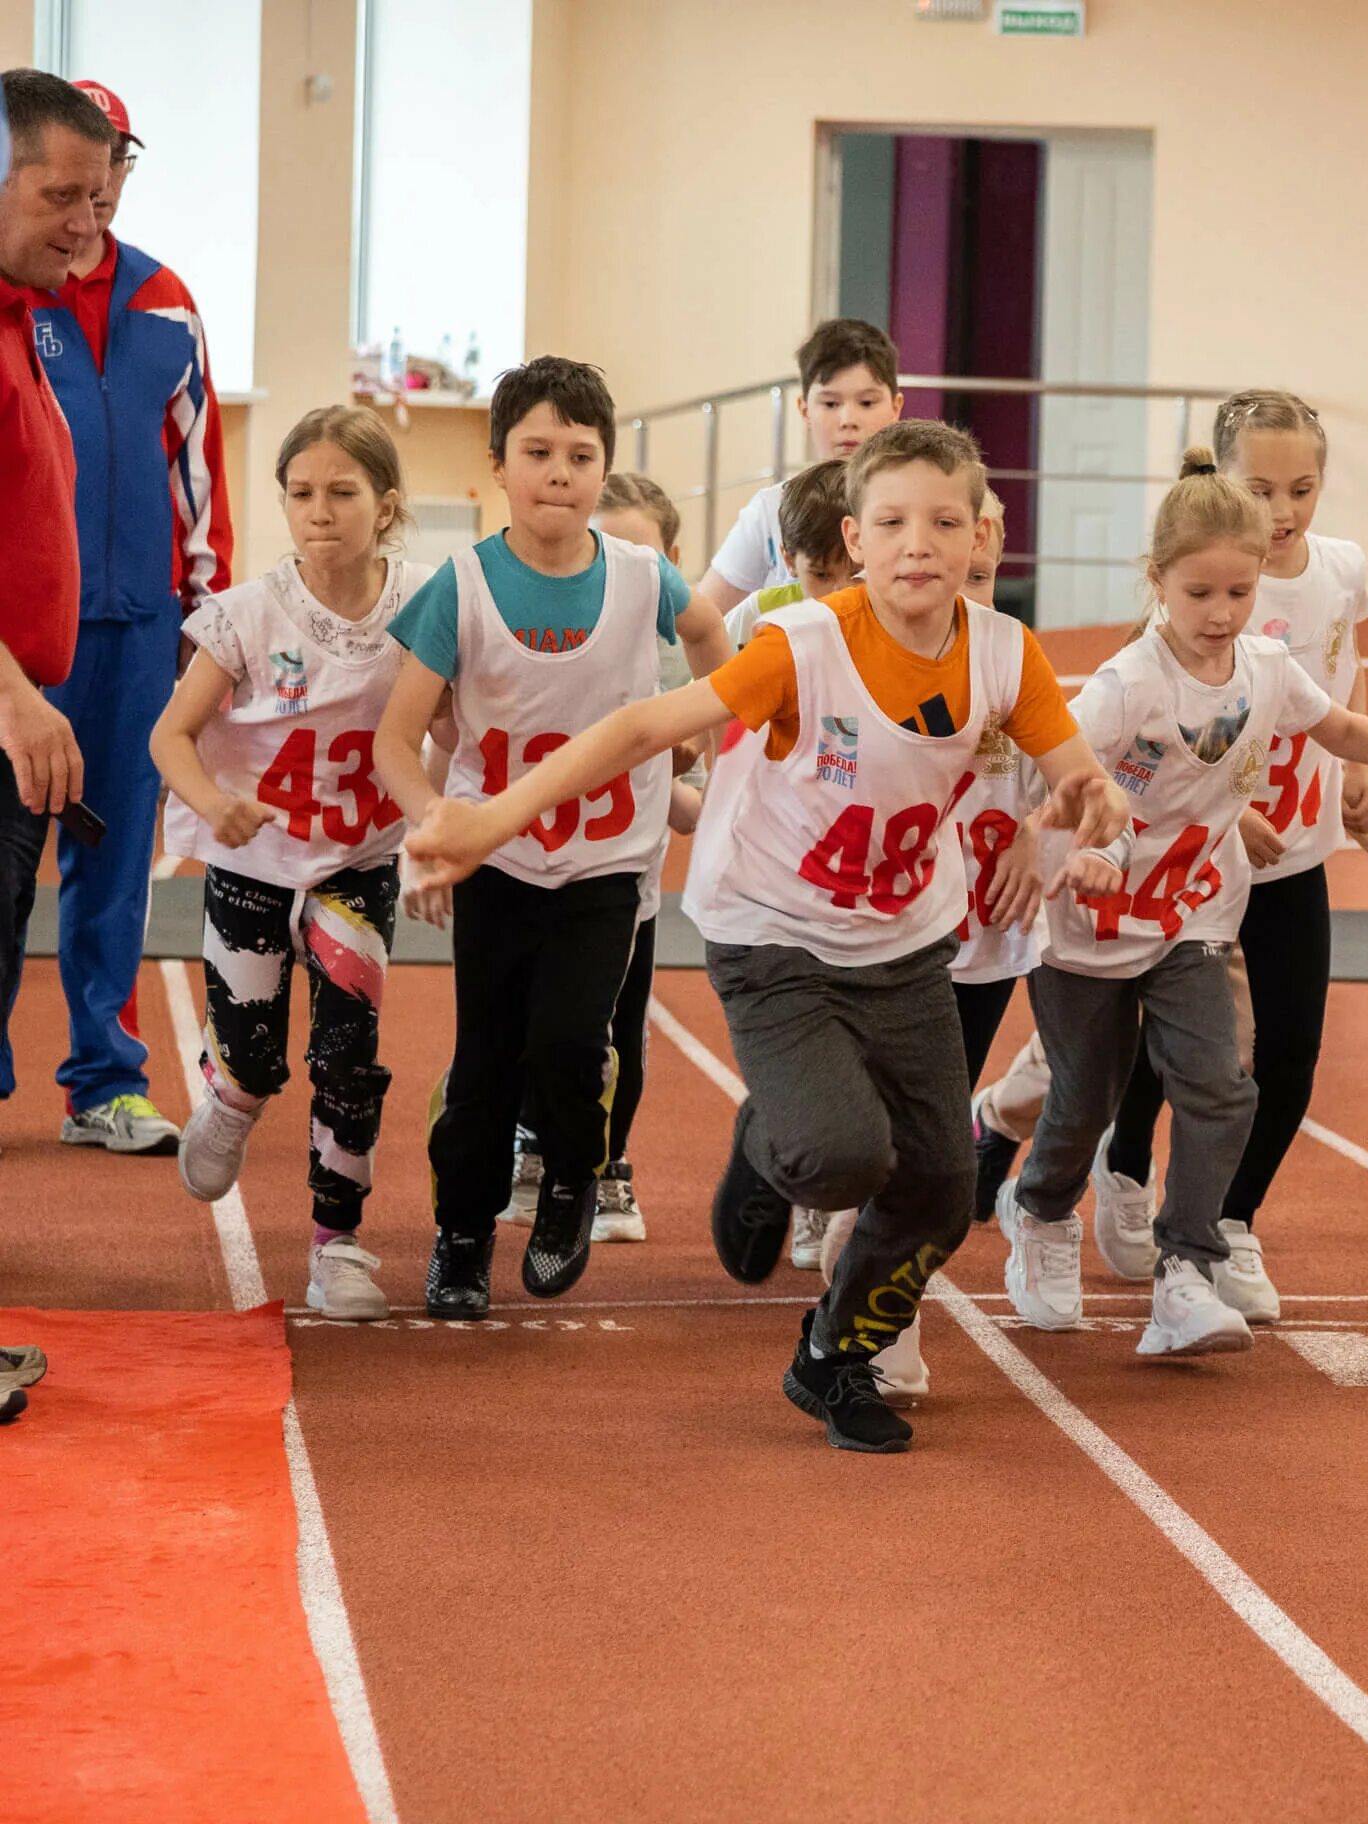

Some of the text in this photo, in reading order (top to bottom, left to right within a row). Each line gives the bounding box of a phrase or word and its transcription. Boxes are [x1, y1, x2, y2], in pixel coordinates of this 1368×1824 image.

[816, 753, 857, 774] ПОБЕДА!
[1115, 760, 1155, 783] ПОБЕДА!
[815, 766, 857, 790] 70 ЛЕТ
[1113, 771, 1150, 796] 70 ЛЕТ
